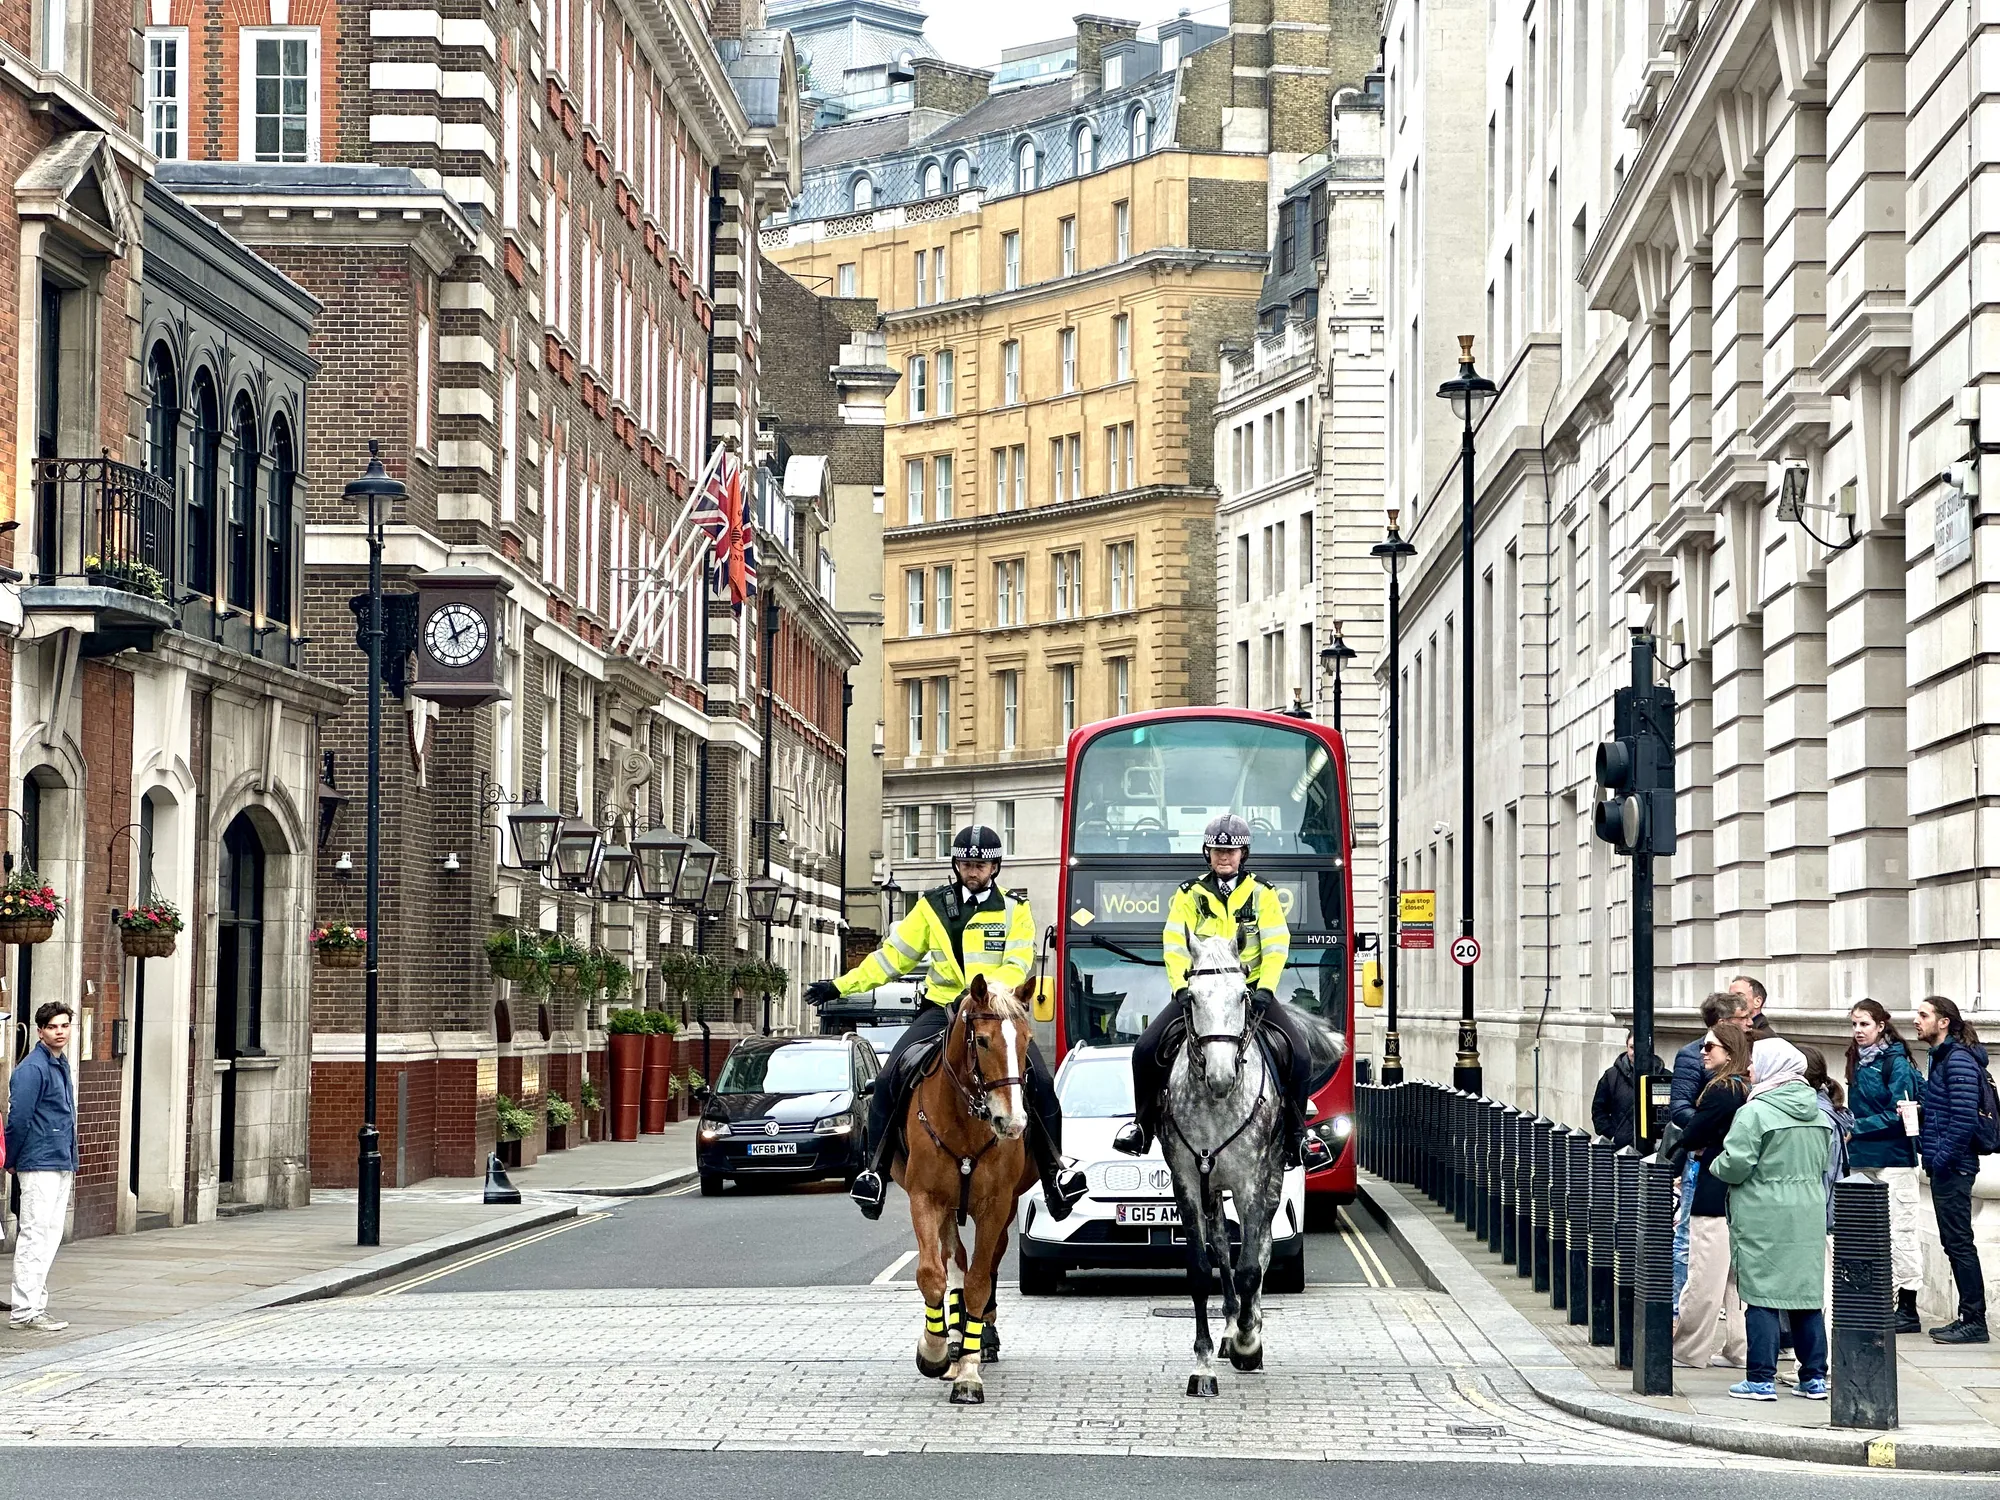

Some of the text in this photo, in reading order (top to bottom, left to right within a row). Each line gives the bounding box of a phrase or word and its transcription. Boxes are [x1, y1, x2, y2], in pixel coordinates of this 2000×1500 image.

[1103, 894, 1160, 914] Wood
[1307, 935, 1337, 944] HV120
[1456, 945, 1476, 957] 20
[752, 1144, 795, 1154] KF68 MYK
[1151, 1169, 1170, 1187] MG
